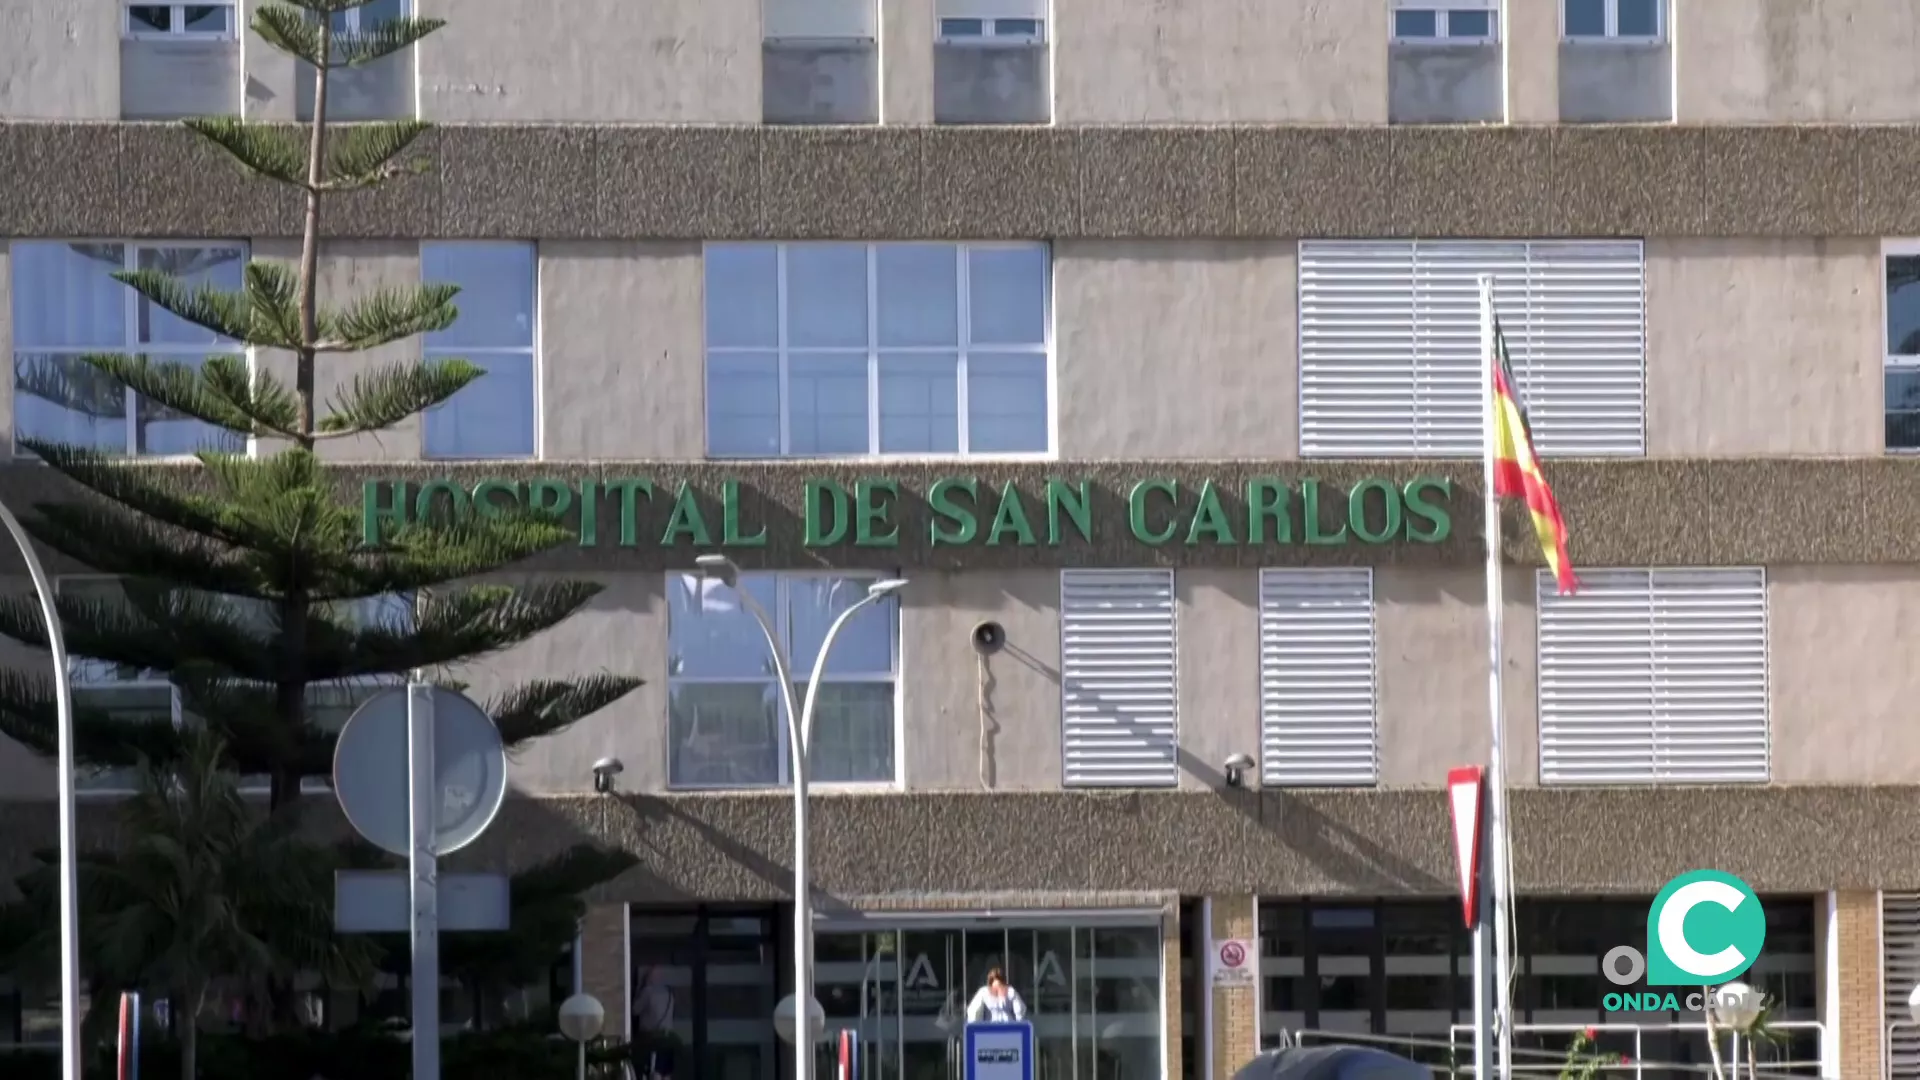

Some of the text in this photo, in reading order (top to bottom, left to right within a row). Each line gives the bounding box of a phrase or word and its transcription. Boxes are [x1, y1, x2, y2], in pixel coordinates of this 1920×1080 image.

[362, 476, 1452, 547] HOSPITAL DE SAN CARLOS
